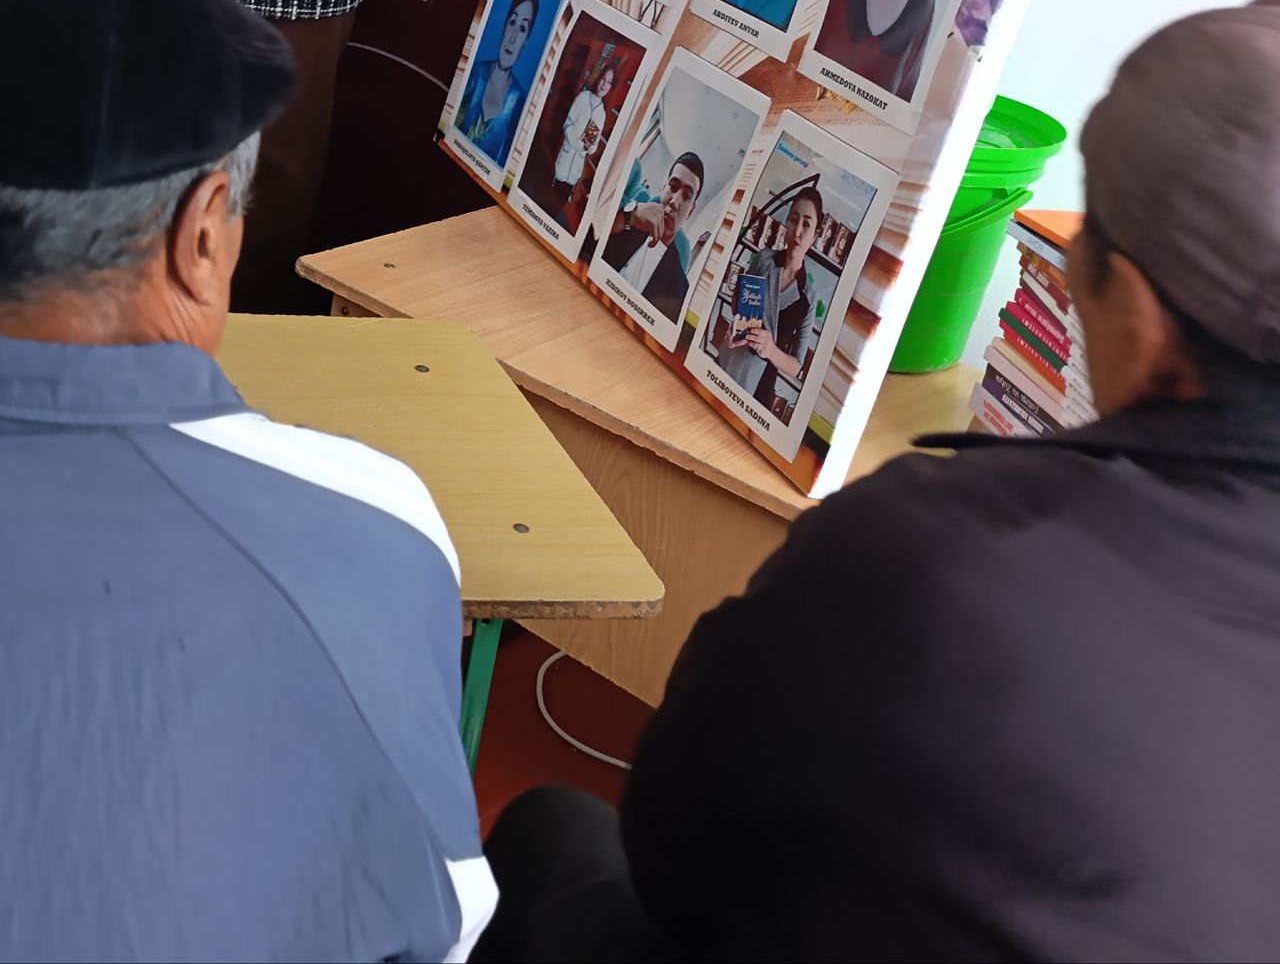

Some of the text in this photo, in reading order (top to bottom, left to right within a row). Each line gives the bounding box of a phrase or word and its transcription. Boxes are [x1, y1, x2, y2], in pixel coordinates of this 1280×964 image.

[712, 9, 760, 39] ABDIYEV ANVAR
[820, 67, 888, 111] AHMEDOVA NAZOKAT
[707, 369, 771, 431] TOLIBOYEVA SADINA
